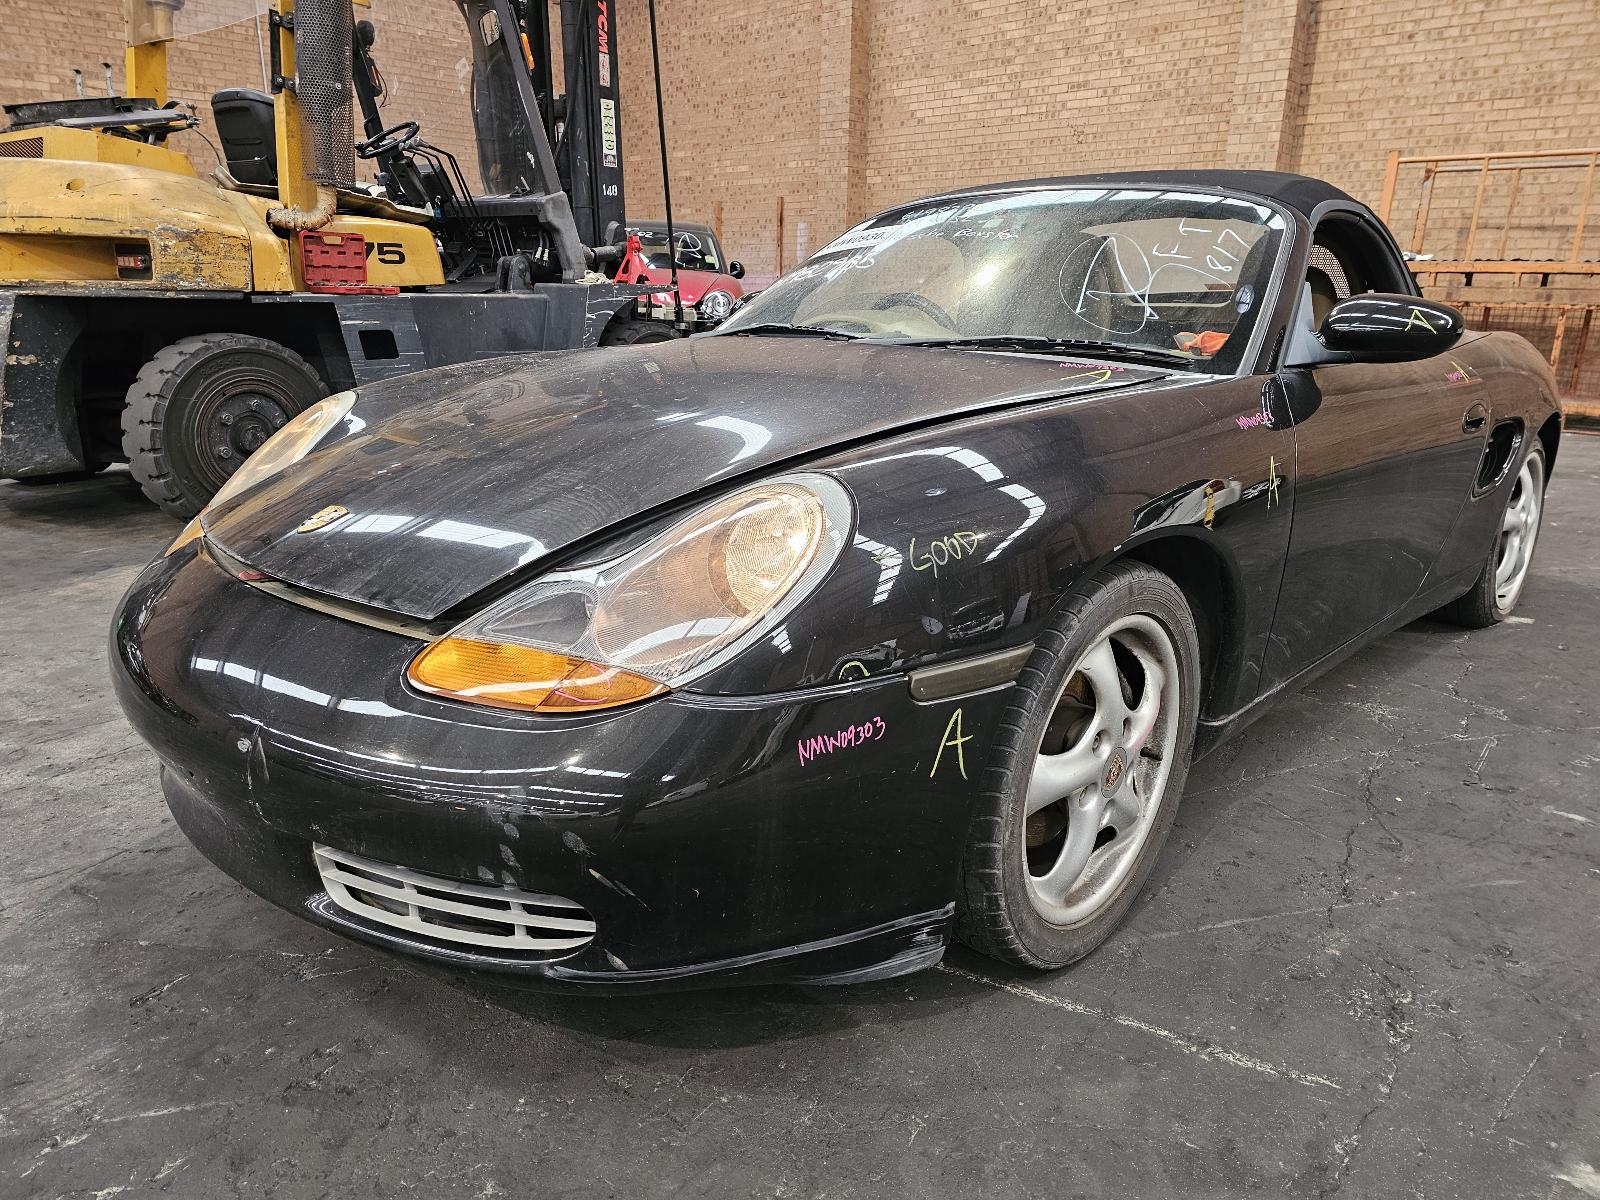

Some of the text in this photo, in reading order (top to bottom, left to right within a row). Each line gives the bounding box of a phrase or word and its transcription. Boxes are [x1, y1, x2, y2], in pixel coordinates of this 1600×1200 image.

[597, 0, 609, 54] TCM
[602, 183, 618, 196] 148
[1404, 309, 1438, 334] A
[909, 531, 978, 578] GOOD
[797, 716, 886, 767] NMW09303
[930, 707, 974, 780] A
